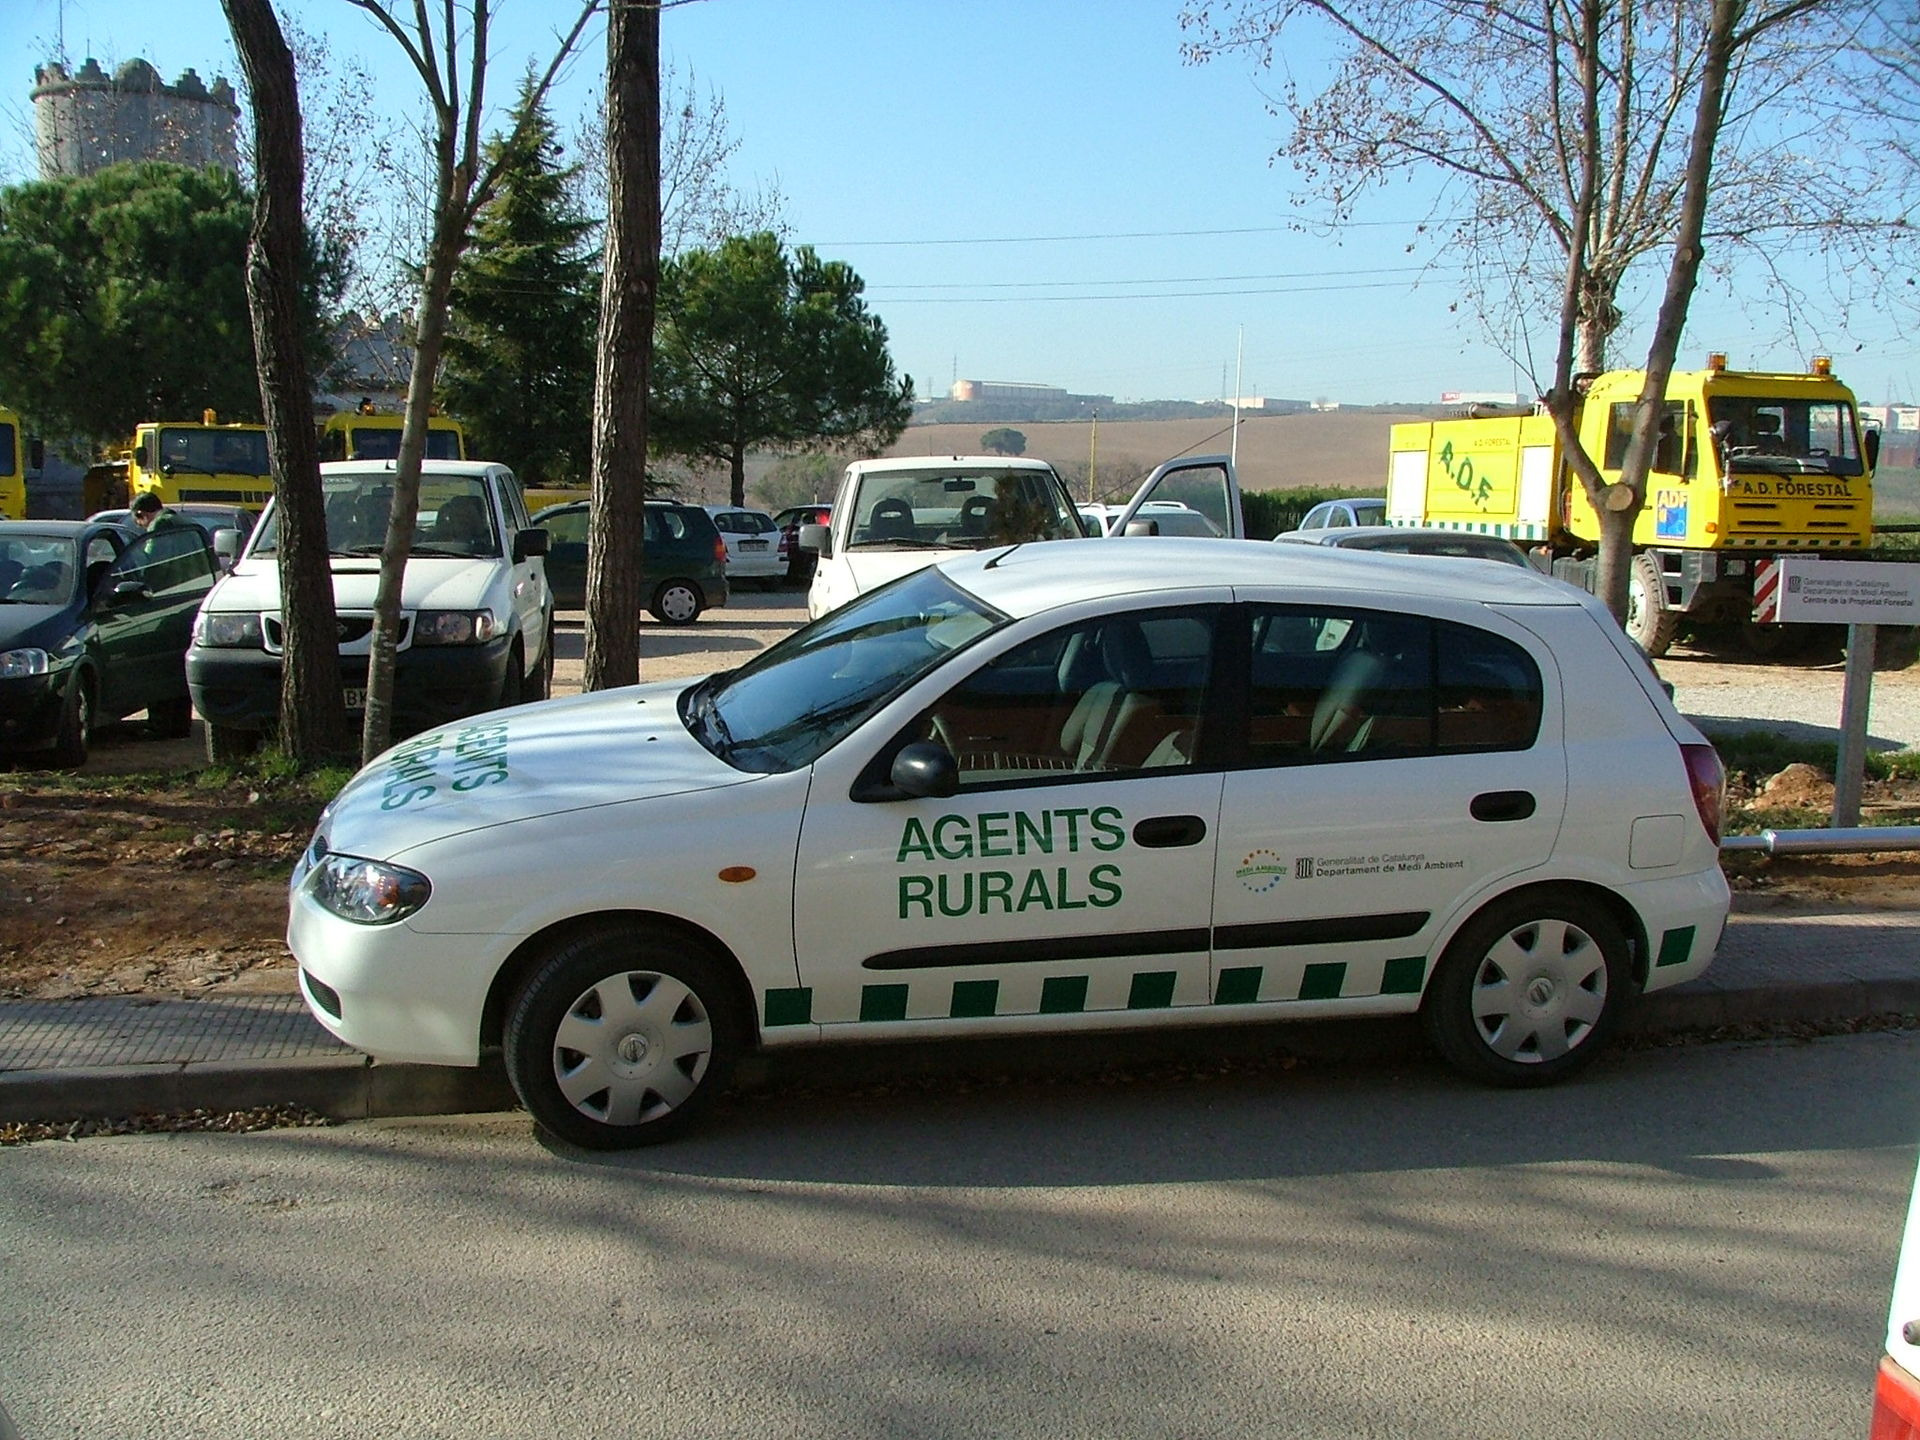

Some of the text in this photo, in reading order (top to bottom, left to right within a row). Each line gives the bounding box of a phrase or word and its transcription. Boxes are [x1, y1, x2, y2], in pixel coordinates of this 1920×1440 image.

[1743, 482, 1852, 497] A.D. FORESTAL
[1658, 490, 1688, 507] ADF
[1802, 596, 1828, 604] Centre
[1829, 596, 1838, 604] de
[1839, 597, 1847, 605] la
[1883, 598, 1913, 607] Forestal
[451, 720, 509, 792] AGENTS
[380, 733, 444, 811] RURALS
[896, 806, 1125, 862] AGENTS
[1317, 852, 1425, 867] Generalitat de Catalunya
[1316, 860, 1464, 877] Departament de Medi Ambient
[898, 864, 1123, 918] RURALS
